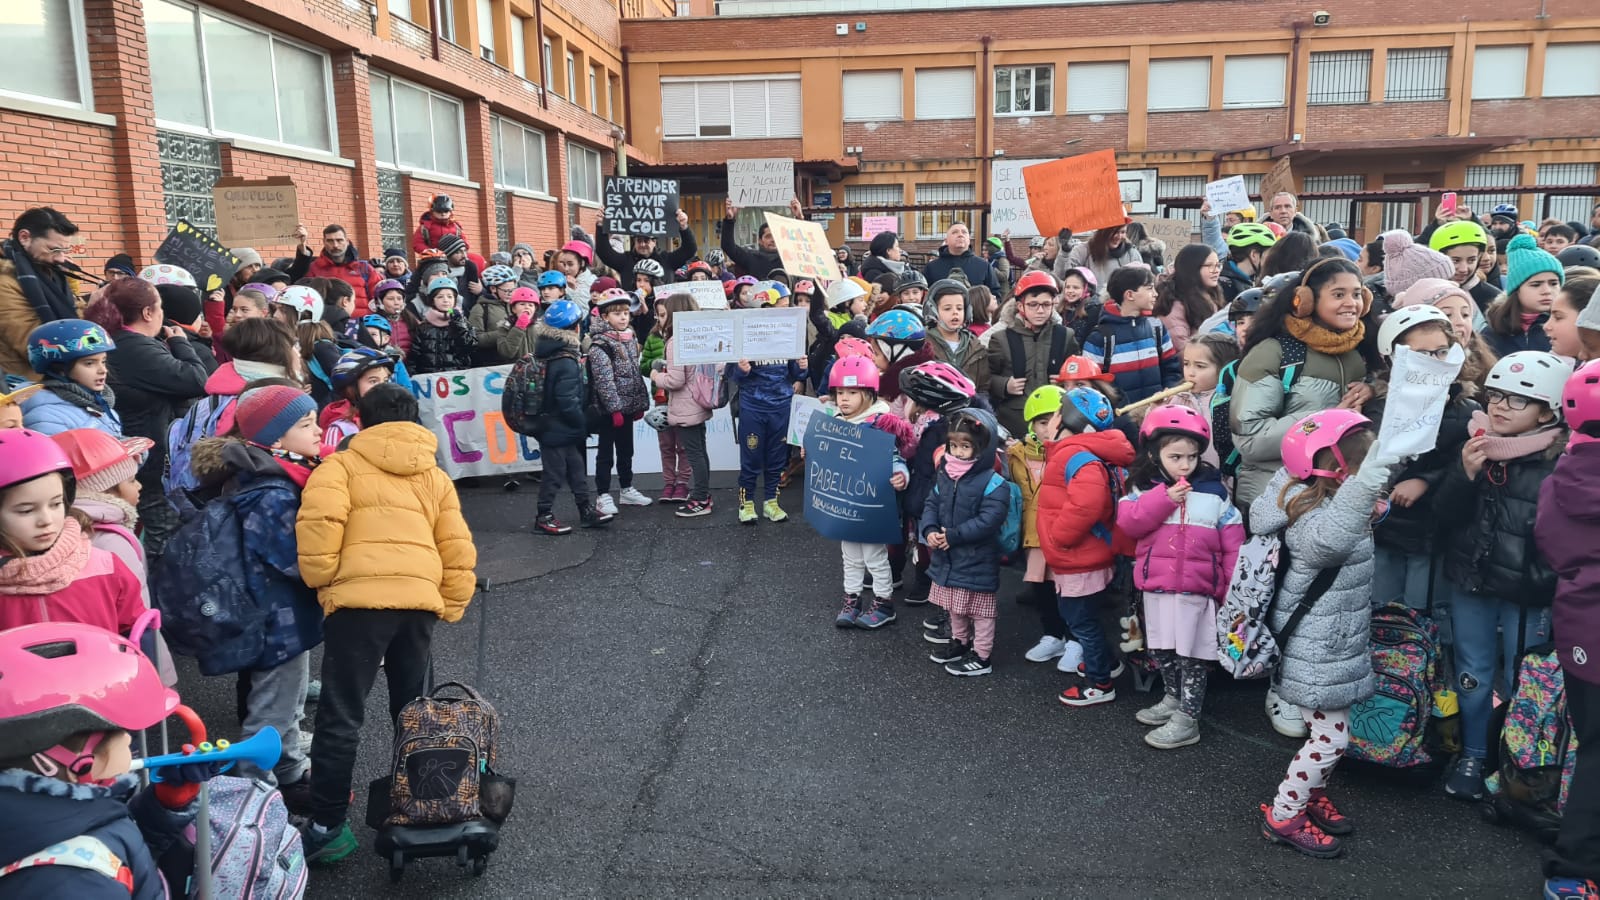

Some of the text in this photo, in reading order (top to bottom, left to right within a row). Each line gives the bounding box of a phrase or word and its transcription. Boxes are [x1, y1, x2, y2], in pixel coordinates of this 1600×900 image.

[605, 177, 677, 194] APRENDER
[733, 176, 744, 187] EL
[606, 194, 667, 207] ES VIVIR
[739, 187, 793, 204] MIENTE
[996, 186, 1025, 201] COLE
[604, 206, 665, 219] SALVAD
[992, 207, 1017, 222] VAMOS
[610, 219, 667, 234] EL COLE
[1151, 224, 1172, 235] NOS
[411, 375, 470, 400] NOS
[818, 441, 857, 463] EN EL
[810, 461, 876, 498] PABELLÓN
